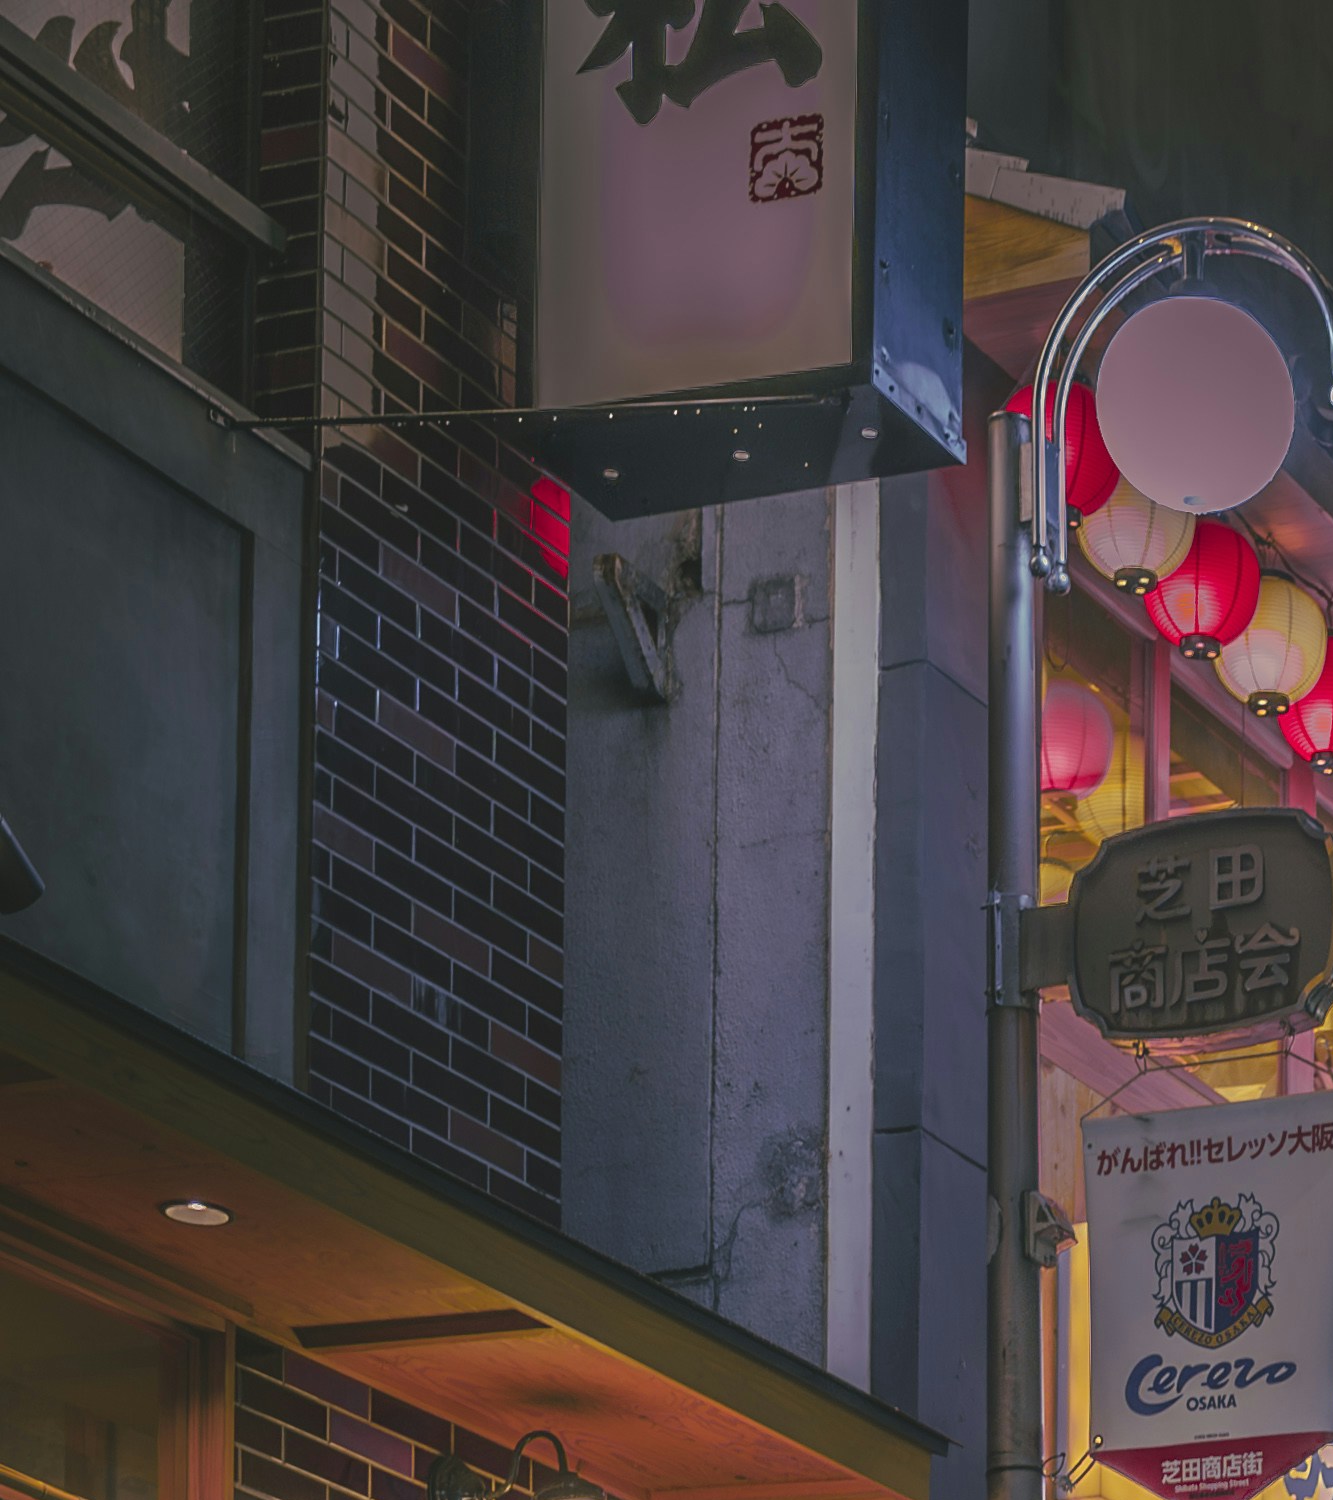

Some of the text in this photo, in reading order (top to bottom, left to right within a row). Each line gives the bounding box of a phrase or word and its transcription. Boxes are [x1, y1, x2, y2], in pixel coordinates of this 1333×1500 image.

[1135, 843, 1264, 924] 芝田
[1109, 925, 1299, 1013] 商店会
[1125, 1353, 1297, 1416] Cerezo
[1186, 1394, 1237, 1412] OSAKA
[1161, 1451, 1263, 1484] 芝田商店街
